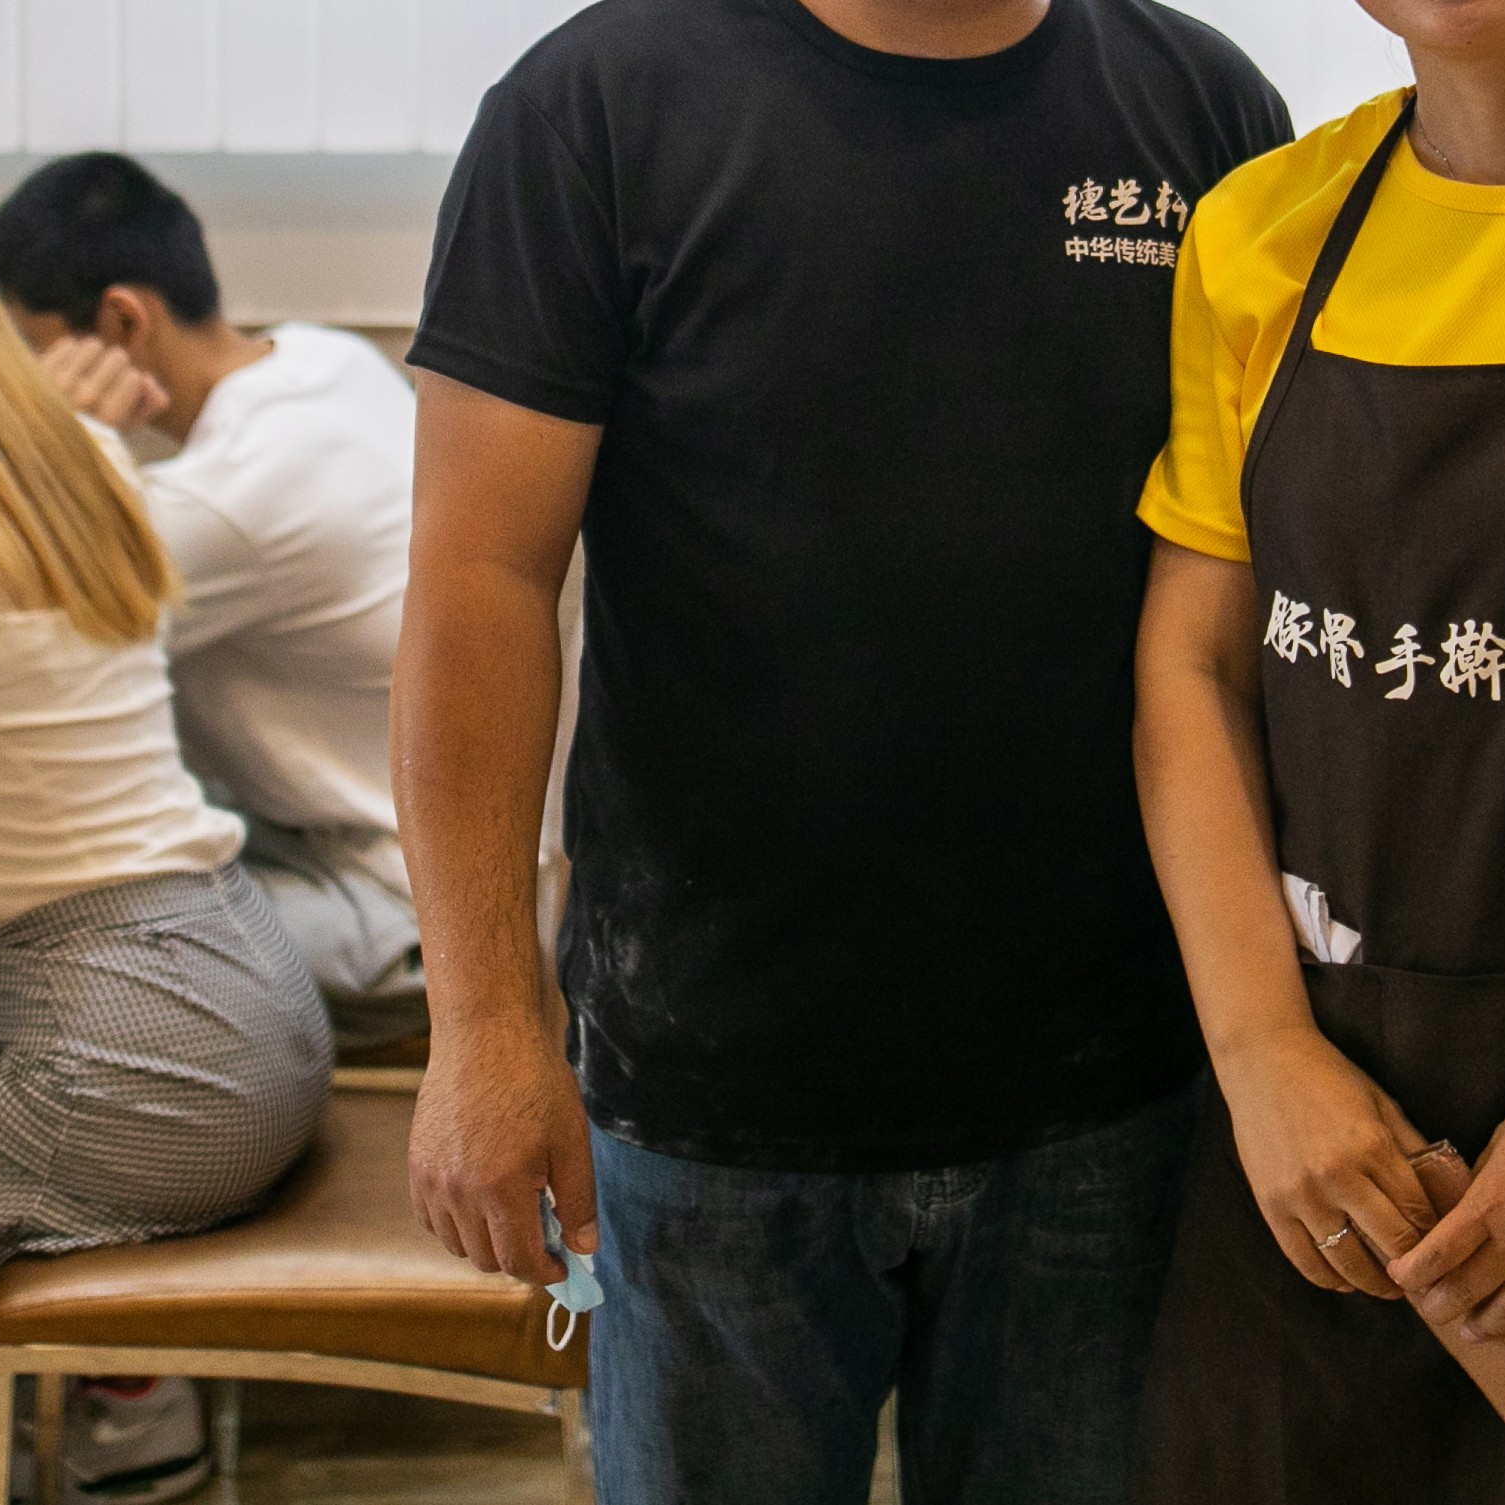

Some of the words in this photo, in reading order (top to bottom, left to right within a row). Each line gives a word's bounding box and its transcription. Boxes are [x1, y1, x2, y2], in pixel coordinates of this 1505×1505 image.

[1064, 235, 1180, 270] 中华传统美
